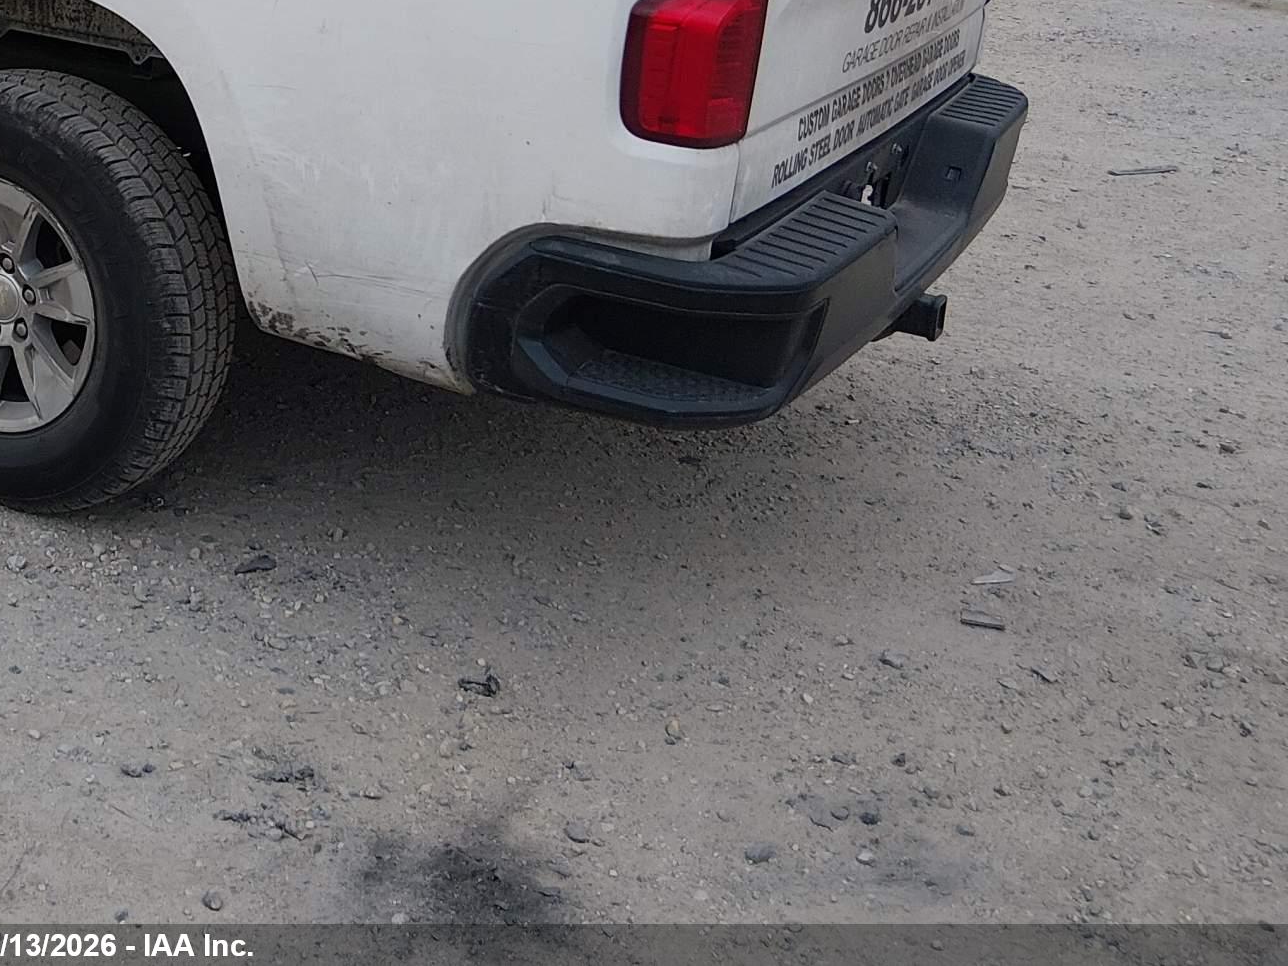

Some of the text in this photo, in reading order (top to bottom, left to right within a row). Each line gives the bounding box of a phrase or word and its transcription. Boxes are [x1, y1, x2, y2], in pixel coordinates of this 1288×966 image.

[842, 40, 880, 73] GARAGE
[879, 29, 903, 57] DOOR
[772, 148, 808, 188] ROLLING
[808, 133, 831, 166] STEEL
[833, 120, 855, 151] DOOR
[856, 96, 894, 137] AUTOMATIC
[893, 86, 910, 113] GATE
[798, 104, 830, 141] CUSTOM
[832, 86, 861, 122] GARAGE
[861, 73, 885, 106] DOORS
